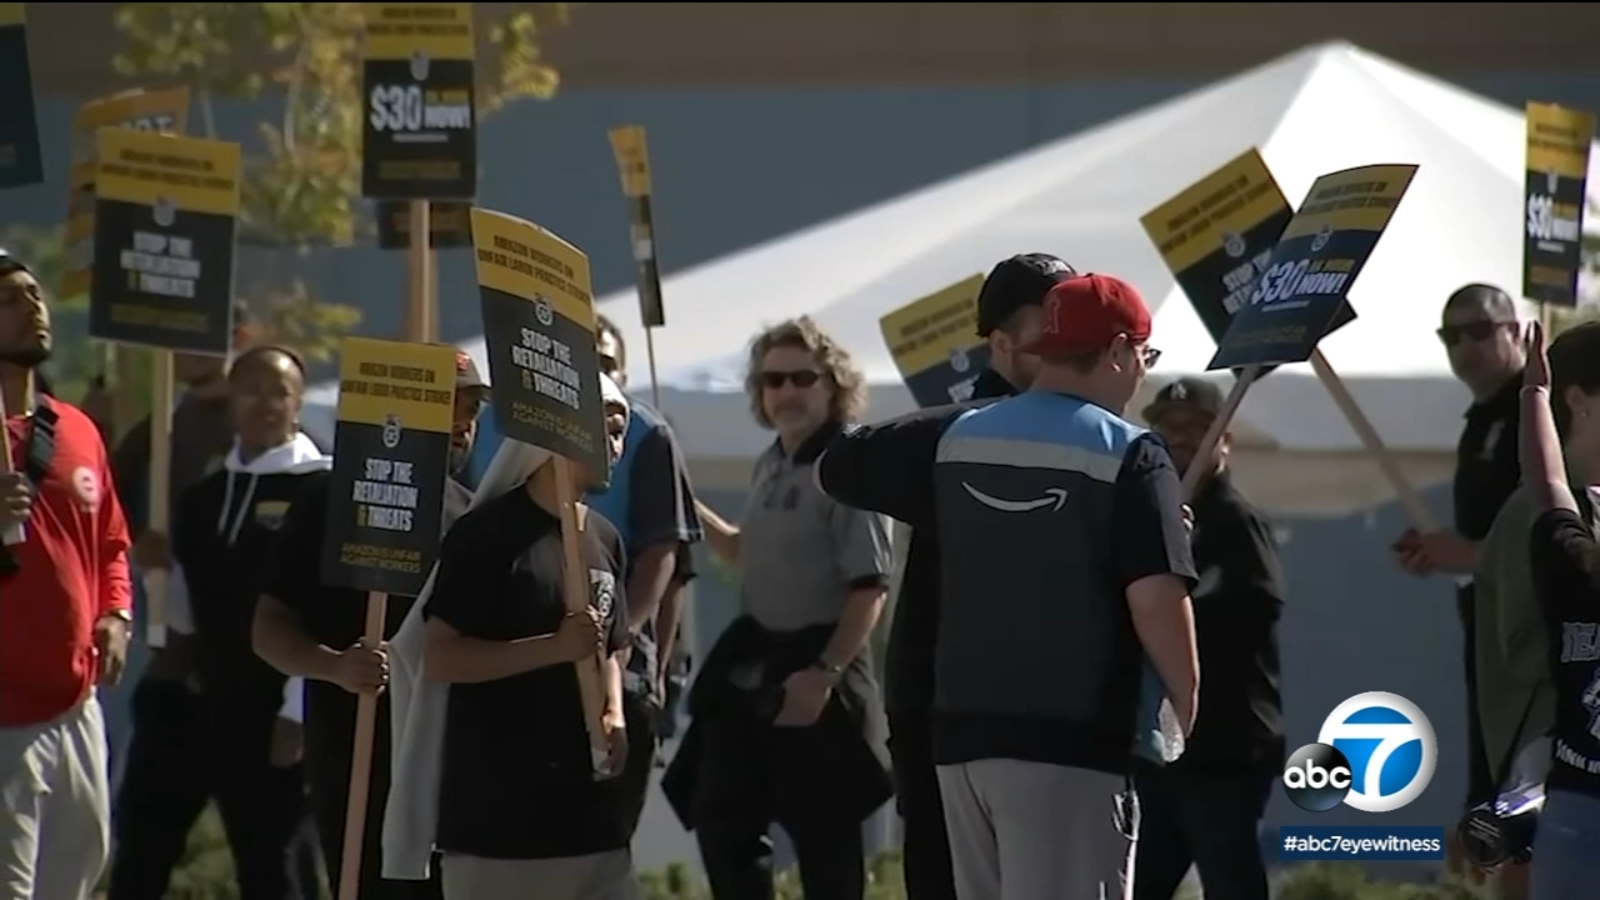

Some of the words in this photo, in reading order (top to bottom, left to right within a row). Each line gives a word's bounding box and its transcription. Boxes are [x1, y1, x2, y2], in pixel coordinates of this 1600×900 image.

[369, 84, 422, 131] $30
[478, 248, 507, 267] UNFAIR
[508, 257, 533, 276] LABOR
[534, 266, 566, 293] PRACTICE
[494, 235, 528, 258] AMAZON
[530, 248, 563, 273] WORKERS
[564, 264, 574, 280] ON
[1252, 258, 1310, 305] $30
[1296, 272, 1349, 294] NOW!
[521, 327, 551, 355] STOP
[553, 340, 572, 365] THE
[360, 362, 388, 377] AMAZON
[390, 365, 423, 382] WORKERS
[512, 345, 581, 392] RETALIATION
[390, 384, 423, 402] PRACTICE
[533, 372, 580, 410] THREATS
[365, 458, 392, 481] STOP
[393, 461, 414, 483] THE
[352, 480, 418, 508] RETALIATION
[367, 506, 413, 531] THREATS
